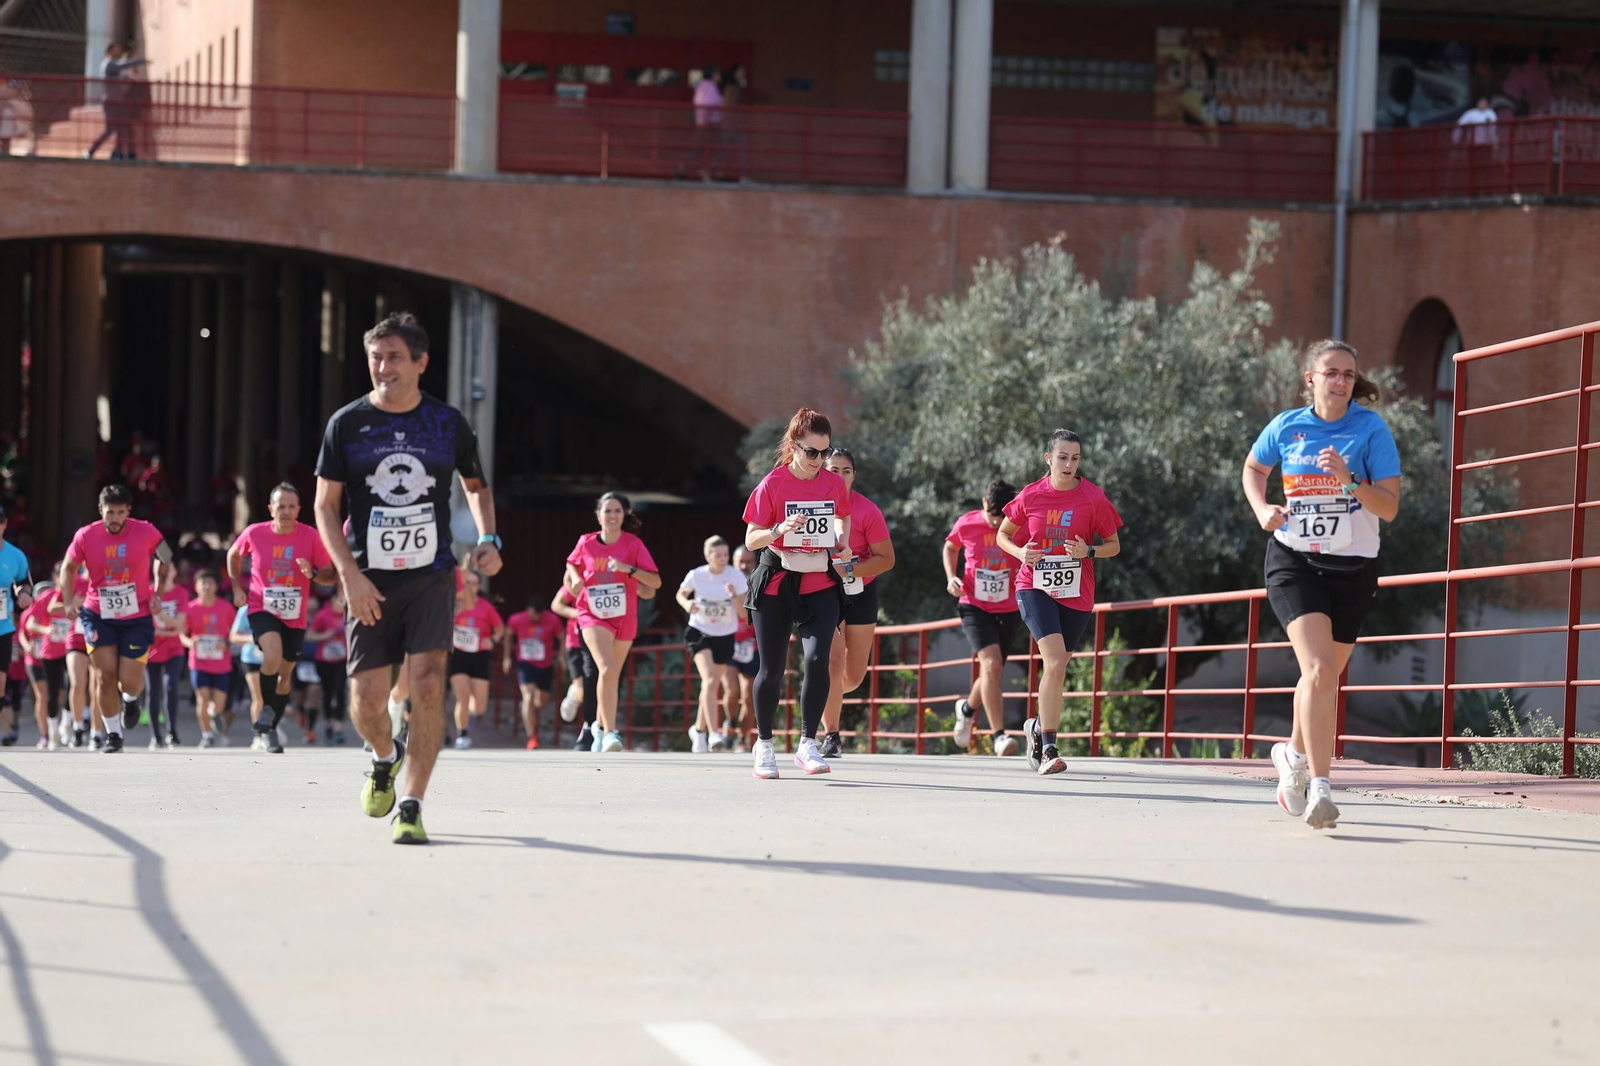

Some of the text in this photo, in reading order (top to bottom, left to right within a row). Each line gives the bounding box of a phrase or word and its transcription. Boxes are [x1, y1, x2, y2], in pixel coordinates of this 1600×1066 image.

[1200, 98, 1329, 129] de málaga
[1292, 505, 1317, 514] UMA
[372, 515, 402, 528] UMA
[1046, 509, 1073, 527] WE
[1299, 516, 1339, 537] 167
[380, 527, 427, 551] 676
[105, 543, 127, 558] WE
[273, 545, 294, 559] WE
[1036, 562, 1058, 570] UMA
[1042, 570, 1074, 587] 589
[982, 580, 1005, 593] 182
[106, 595, 132, 610] 391
[270, 598, 296, 611] 438
[595, 595, 621, 609] 608
[705, 606, 727, 617] 692
